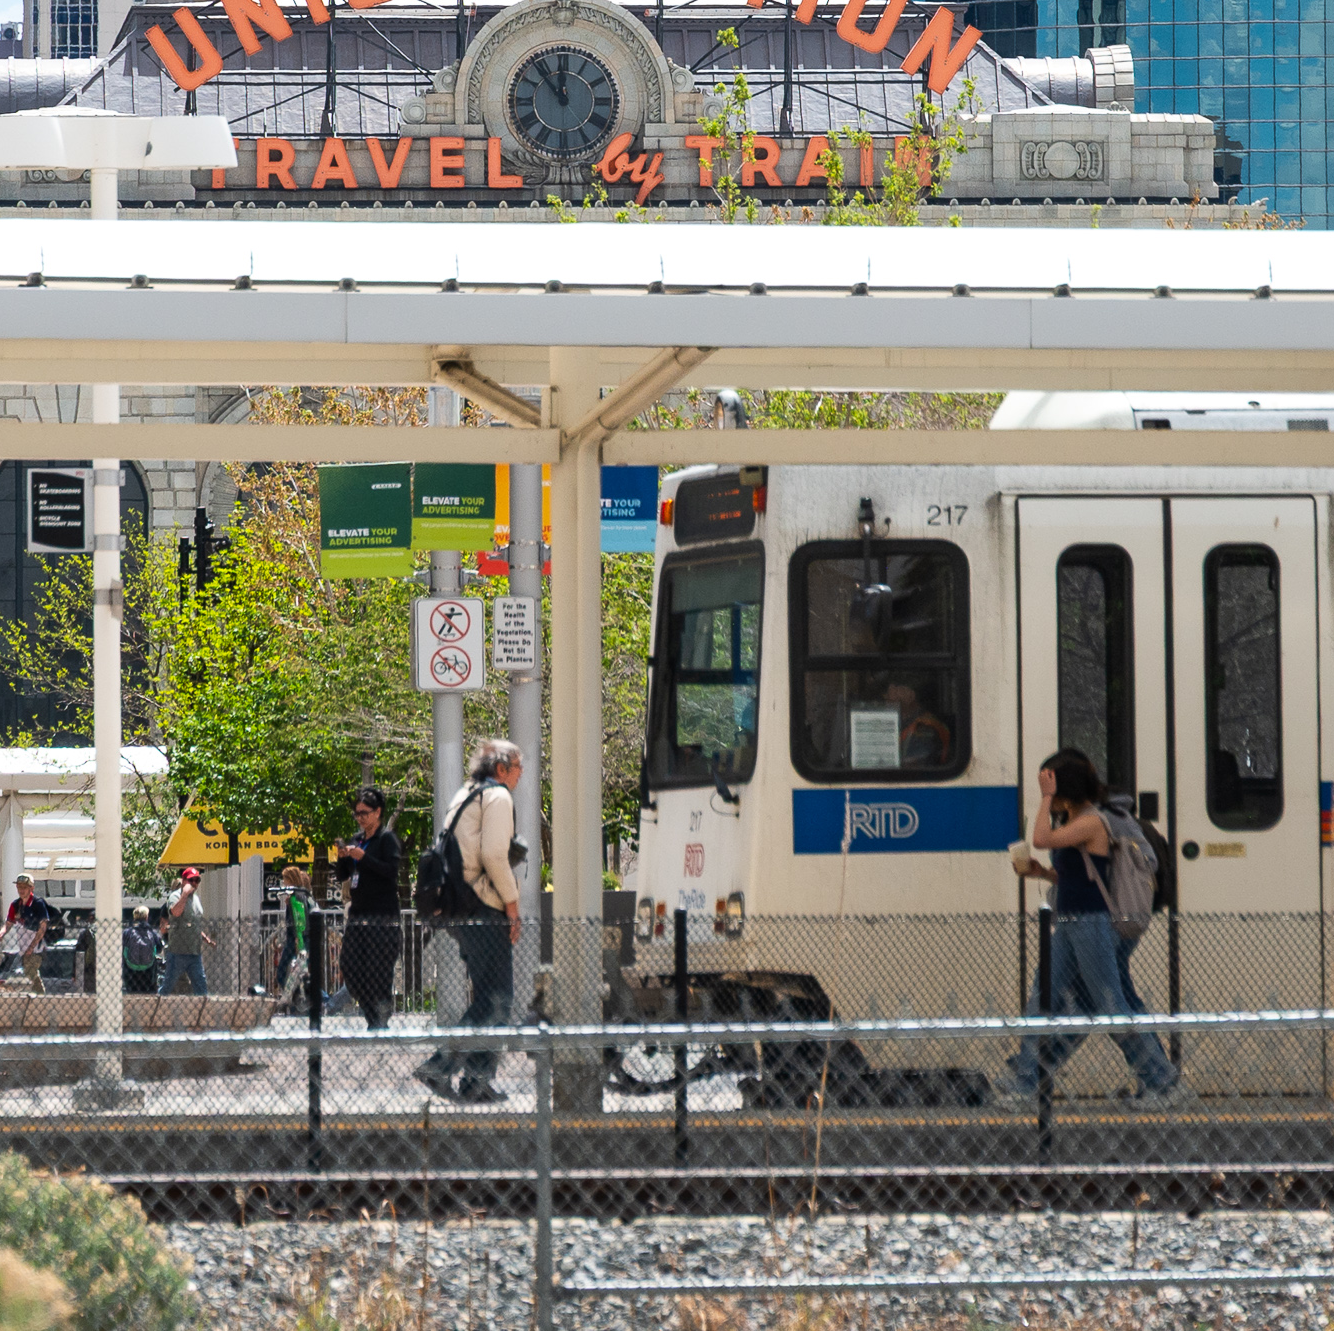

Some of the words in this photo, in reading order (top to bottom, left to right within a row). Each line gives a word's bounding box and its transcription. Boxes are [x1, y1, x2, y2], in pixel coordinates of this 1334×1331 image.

[595, 132, 665, 206] by
[422, 496, 460, 505] ELEVATE
[461, 497, 485, 506] YOUR
[613, 499, 641, 508] YOUR
[422, 506, 480, 515] ADVERTISING
[927, 505, 968, 525] 217
[328, 528, 370, 537] ELEVATE
[371, 527, 398, 536] YOUR
[329, 536, 393, 546] ADVERTISING
[848, 802, 919, 839] RTD
[205, 841, 251, 850] KORAN
[256, 841, 278, 849] BBQ
